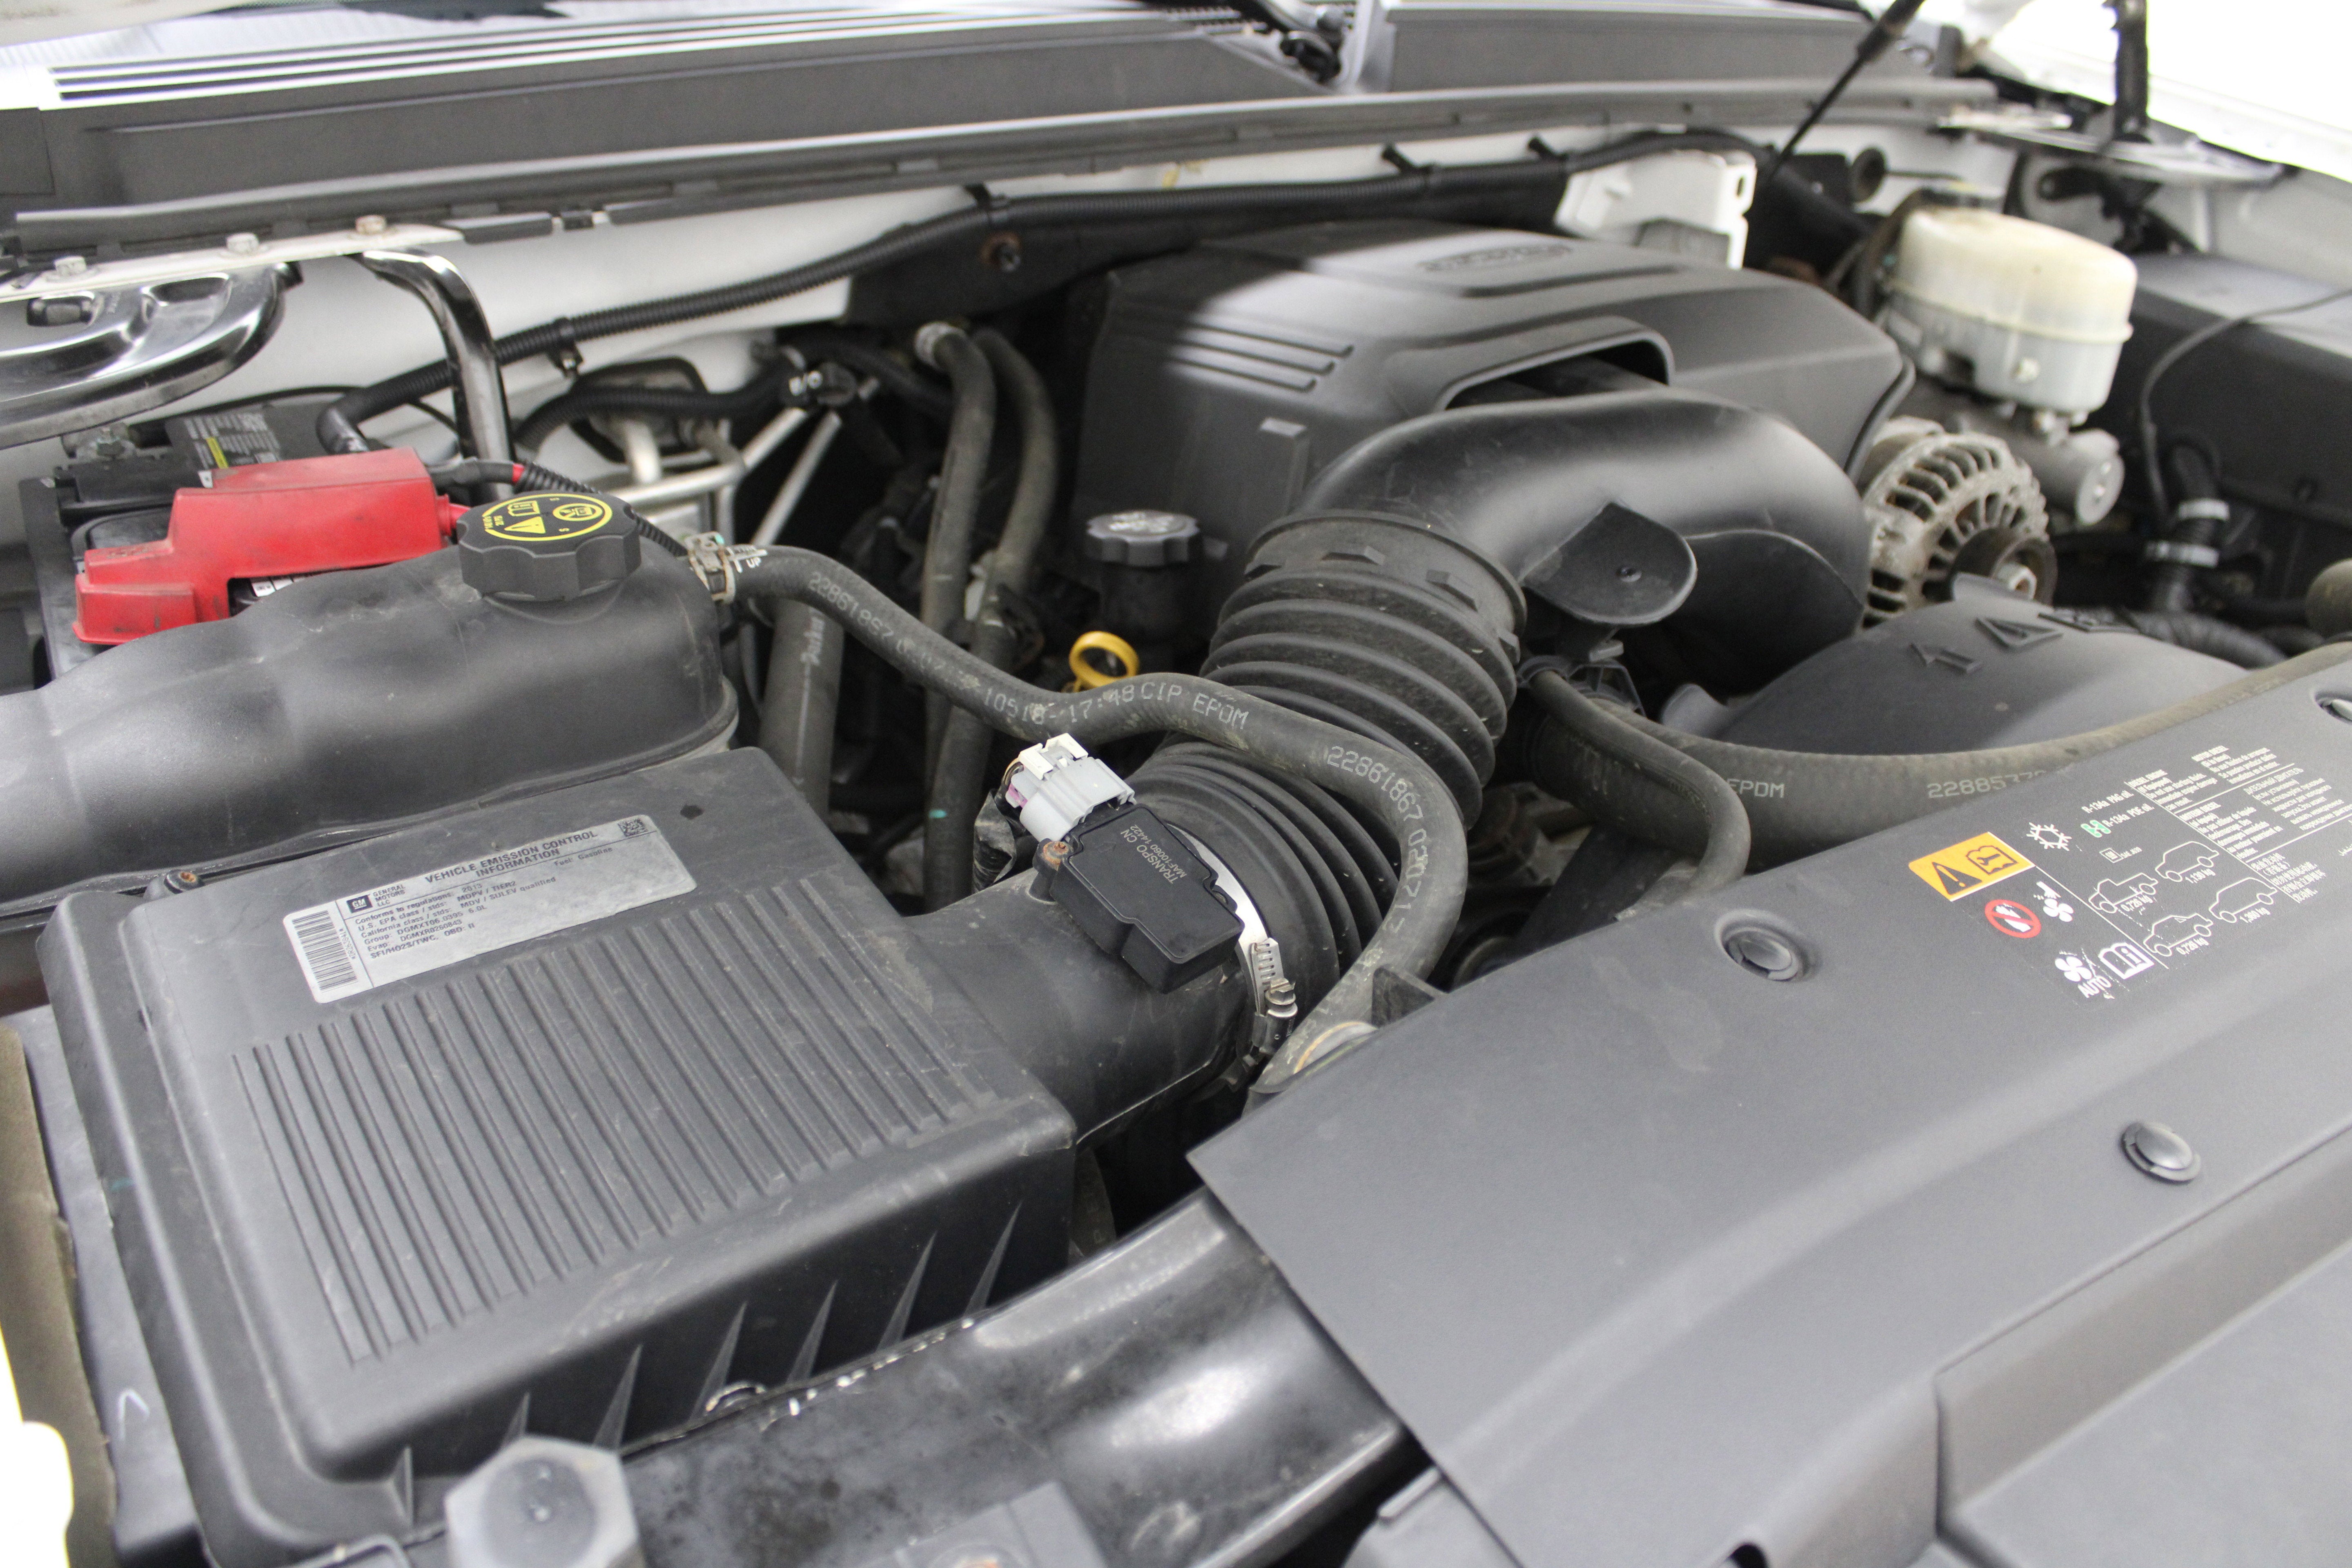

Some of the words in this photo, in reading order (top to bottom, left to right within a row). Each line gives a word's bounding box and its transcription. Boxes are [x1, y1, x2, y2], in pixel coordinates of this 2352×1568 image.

[1327, 746, 1423, 822] 22861867
[2081, 800, 2111, 813] R-134a
[2106, 793, 2124, 804] PAG
[2102, 814, 2131, 827] R-134a
[2127, 806, 2144, 817] POE
[1120, 829, 1138, 843] CN
[1130, 824, 1152, 844] 14422
[425, 863, 477, 884] VEHICLE
[480, 845, 539, 867] EMISSION
[542, 830, 598, 851] CONTROL
[476, 848, 560, 877] INFORMATION
[554, 858, 572, 867] Fuel:
[578, 846, 613, 860] Gasoline
[1136, 844, 1178, 884] TRANSPO
[1150, 844, 1187, 878] MAF10060
[373, 884, 405, 897] GENERAL
[375, 890, 405, 902] MOTORS
[355, 909, 394, 924] Conforms
[408, 892, 454, 910] regulations:
[462, 884, 483, 893] 2013
[361, 923, 401, 938] California
[403, 916, 424, 926] class
[433, 907, 452, 917] stds:
[460, 899, 481, 909] MDV
[490, 888, 517, 900] SULEV
[520, 876, 557, 891] qualified
[379, 917, 397, 925] EPA
[399, 910, 419, 919] class
[428, 901, 447, 911] stds:
[457, 891, 483, 902] MDPV
[491, 881, 516, 892] TIER2
[364, 933, 391, 946] Group:
[469, 904, 488, 913] 6.0L
[444, 926, 465, 937] OBD:
[368, 942, 390, 952] Evap:
[2078, 976, 2112, 998] AUTO
